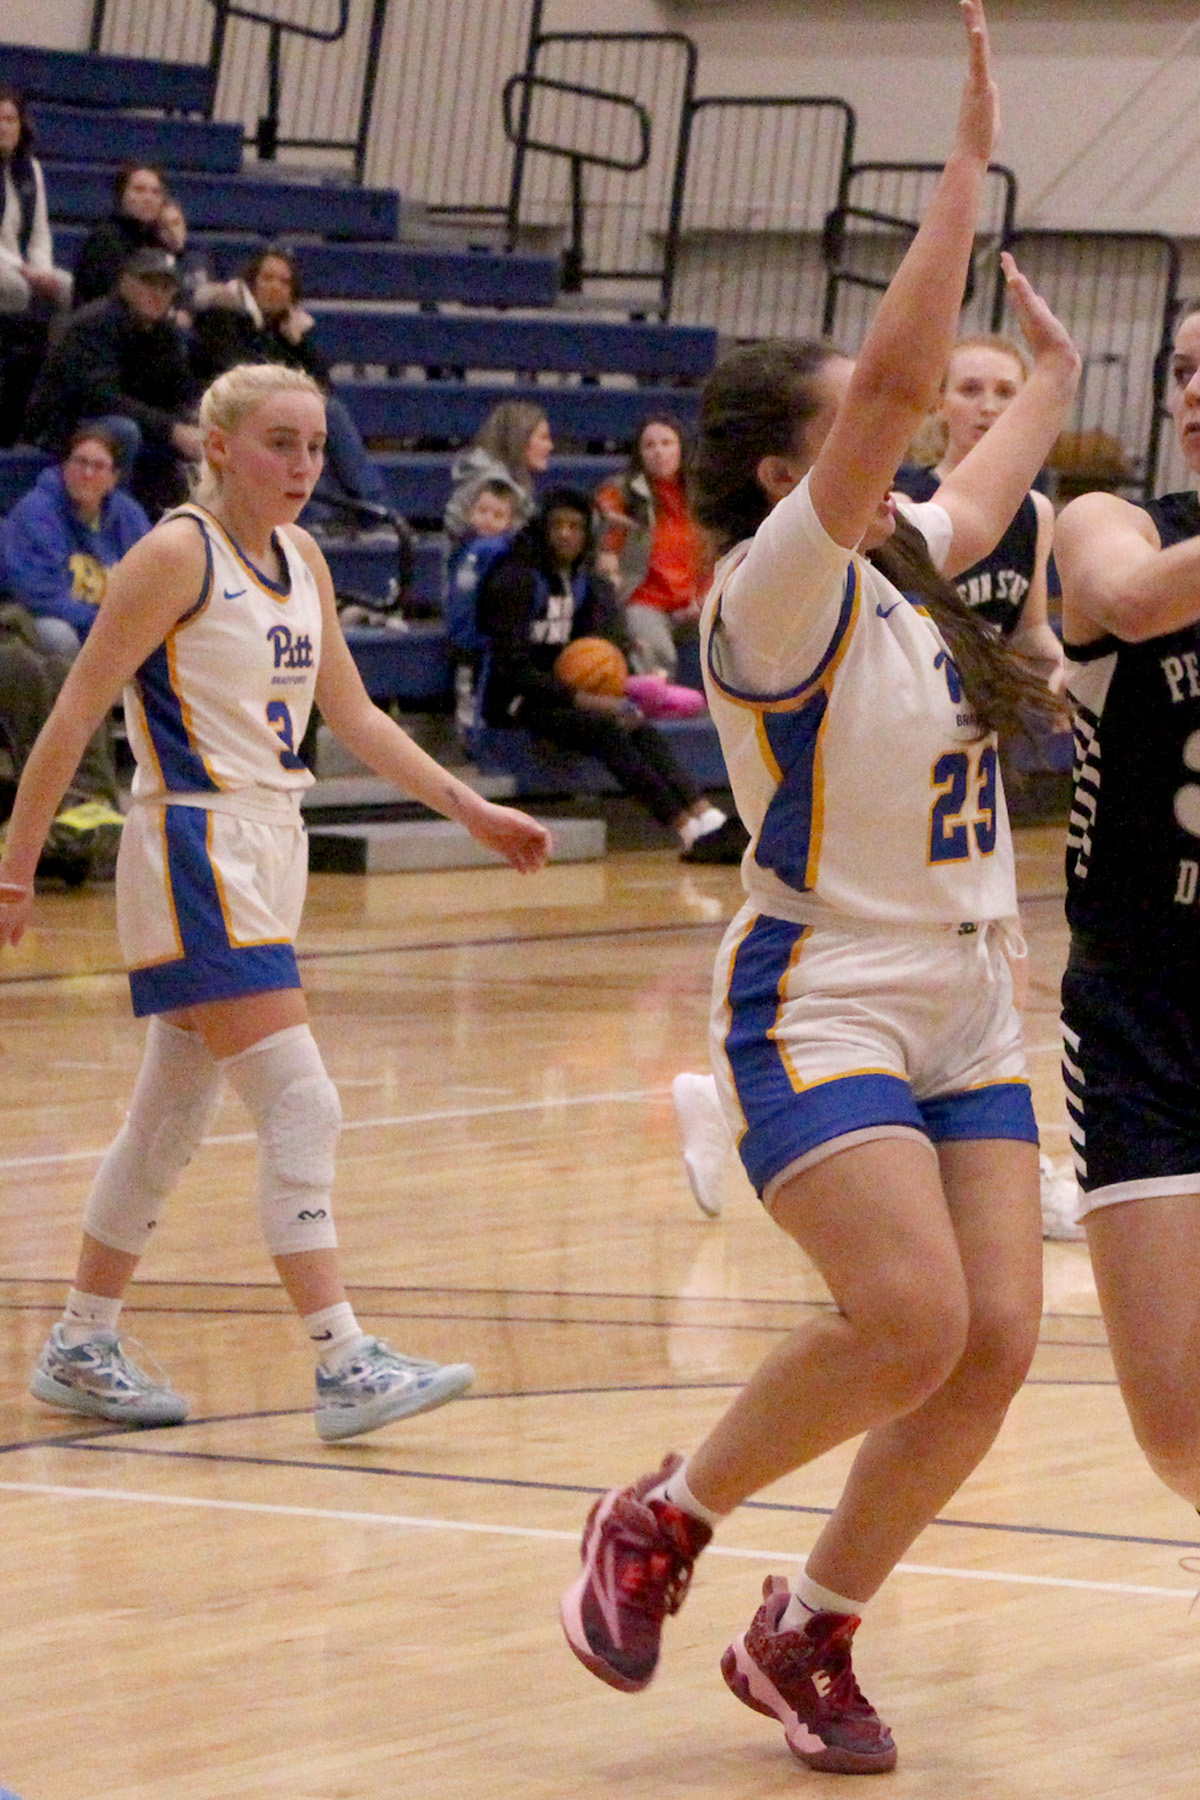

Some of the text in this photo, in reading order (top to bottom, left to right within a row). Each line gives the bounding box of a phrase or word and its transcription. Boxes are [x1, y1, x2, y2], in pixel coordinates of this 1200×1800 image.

[267, 625, 314, 668] Pitt
[265, 699, 308, 773] 3
[926, 746, 997, 867] 23
